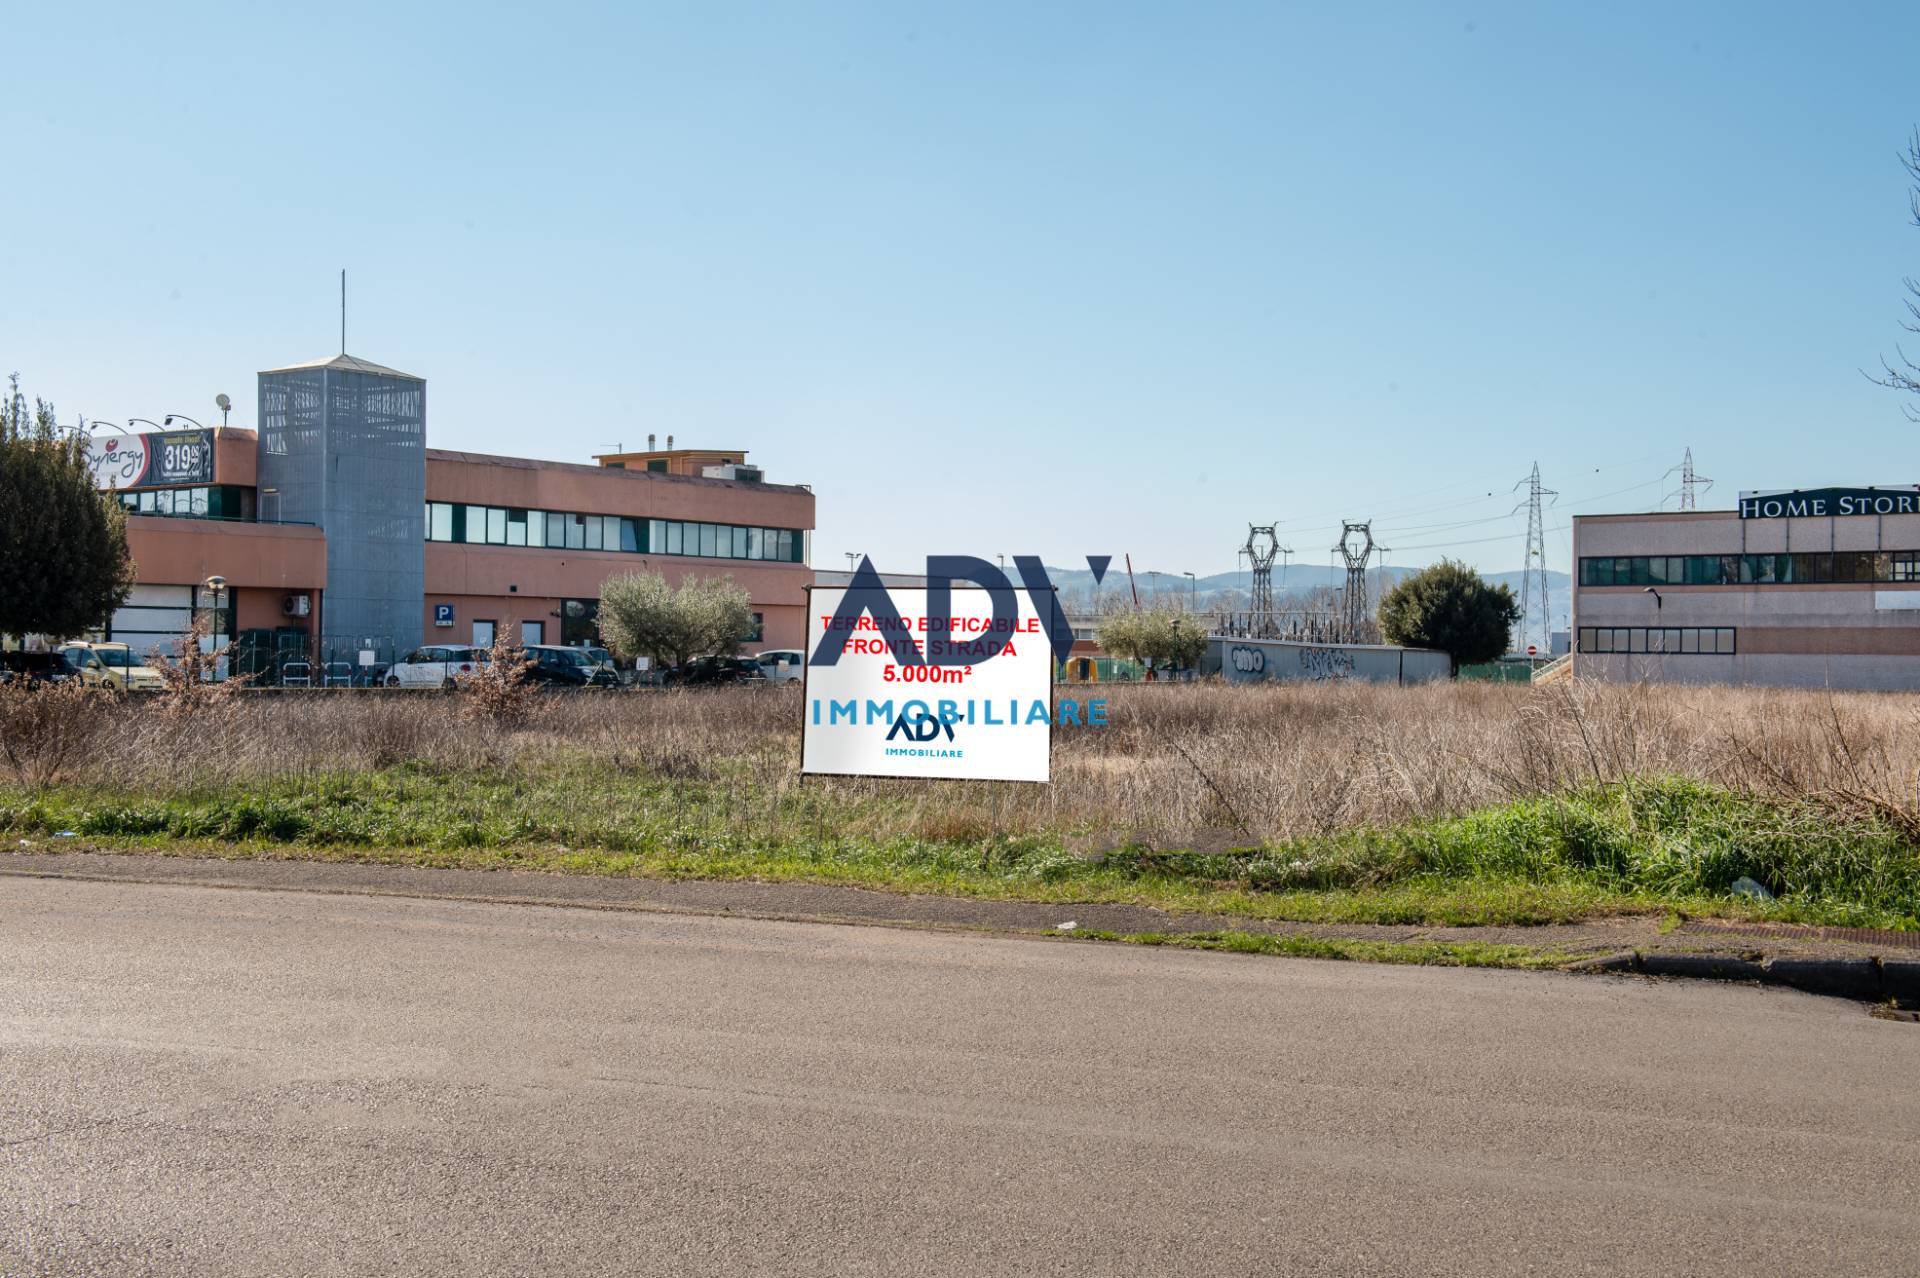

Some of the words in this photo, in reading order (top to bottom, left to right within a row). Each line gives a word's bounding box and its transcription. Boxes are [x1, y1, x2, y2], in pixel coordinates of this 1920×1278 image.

[1741, 500, 1827, 518] HOME
[439, 606, 449, 619] P
[821, 615, 913, 632] TERRENO
[918, 616, 1039, 633] EDIFICABILE
[842, 639, 924, 656] FRONTE
[931, 640, 1017, 657] STRADA
[883, 664, 972, 684] 5.000m²
[885, 713, 964, 743] ADV
[885, 747, 963, 758] IMMOBILIARE
